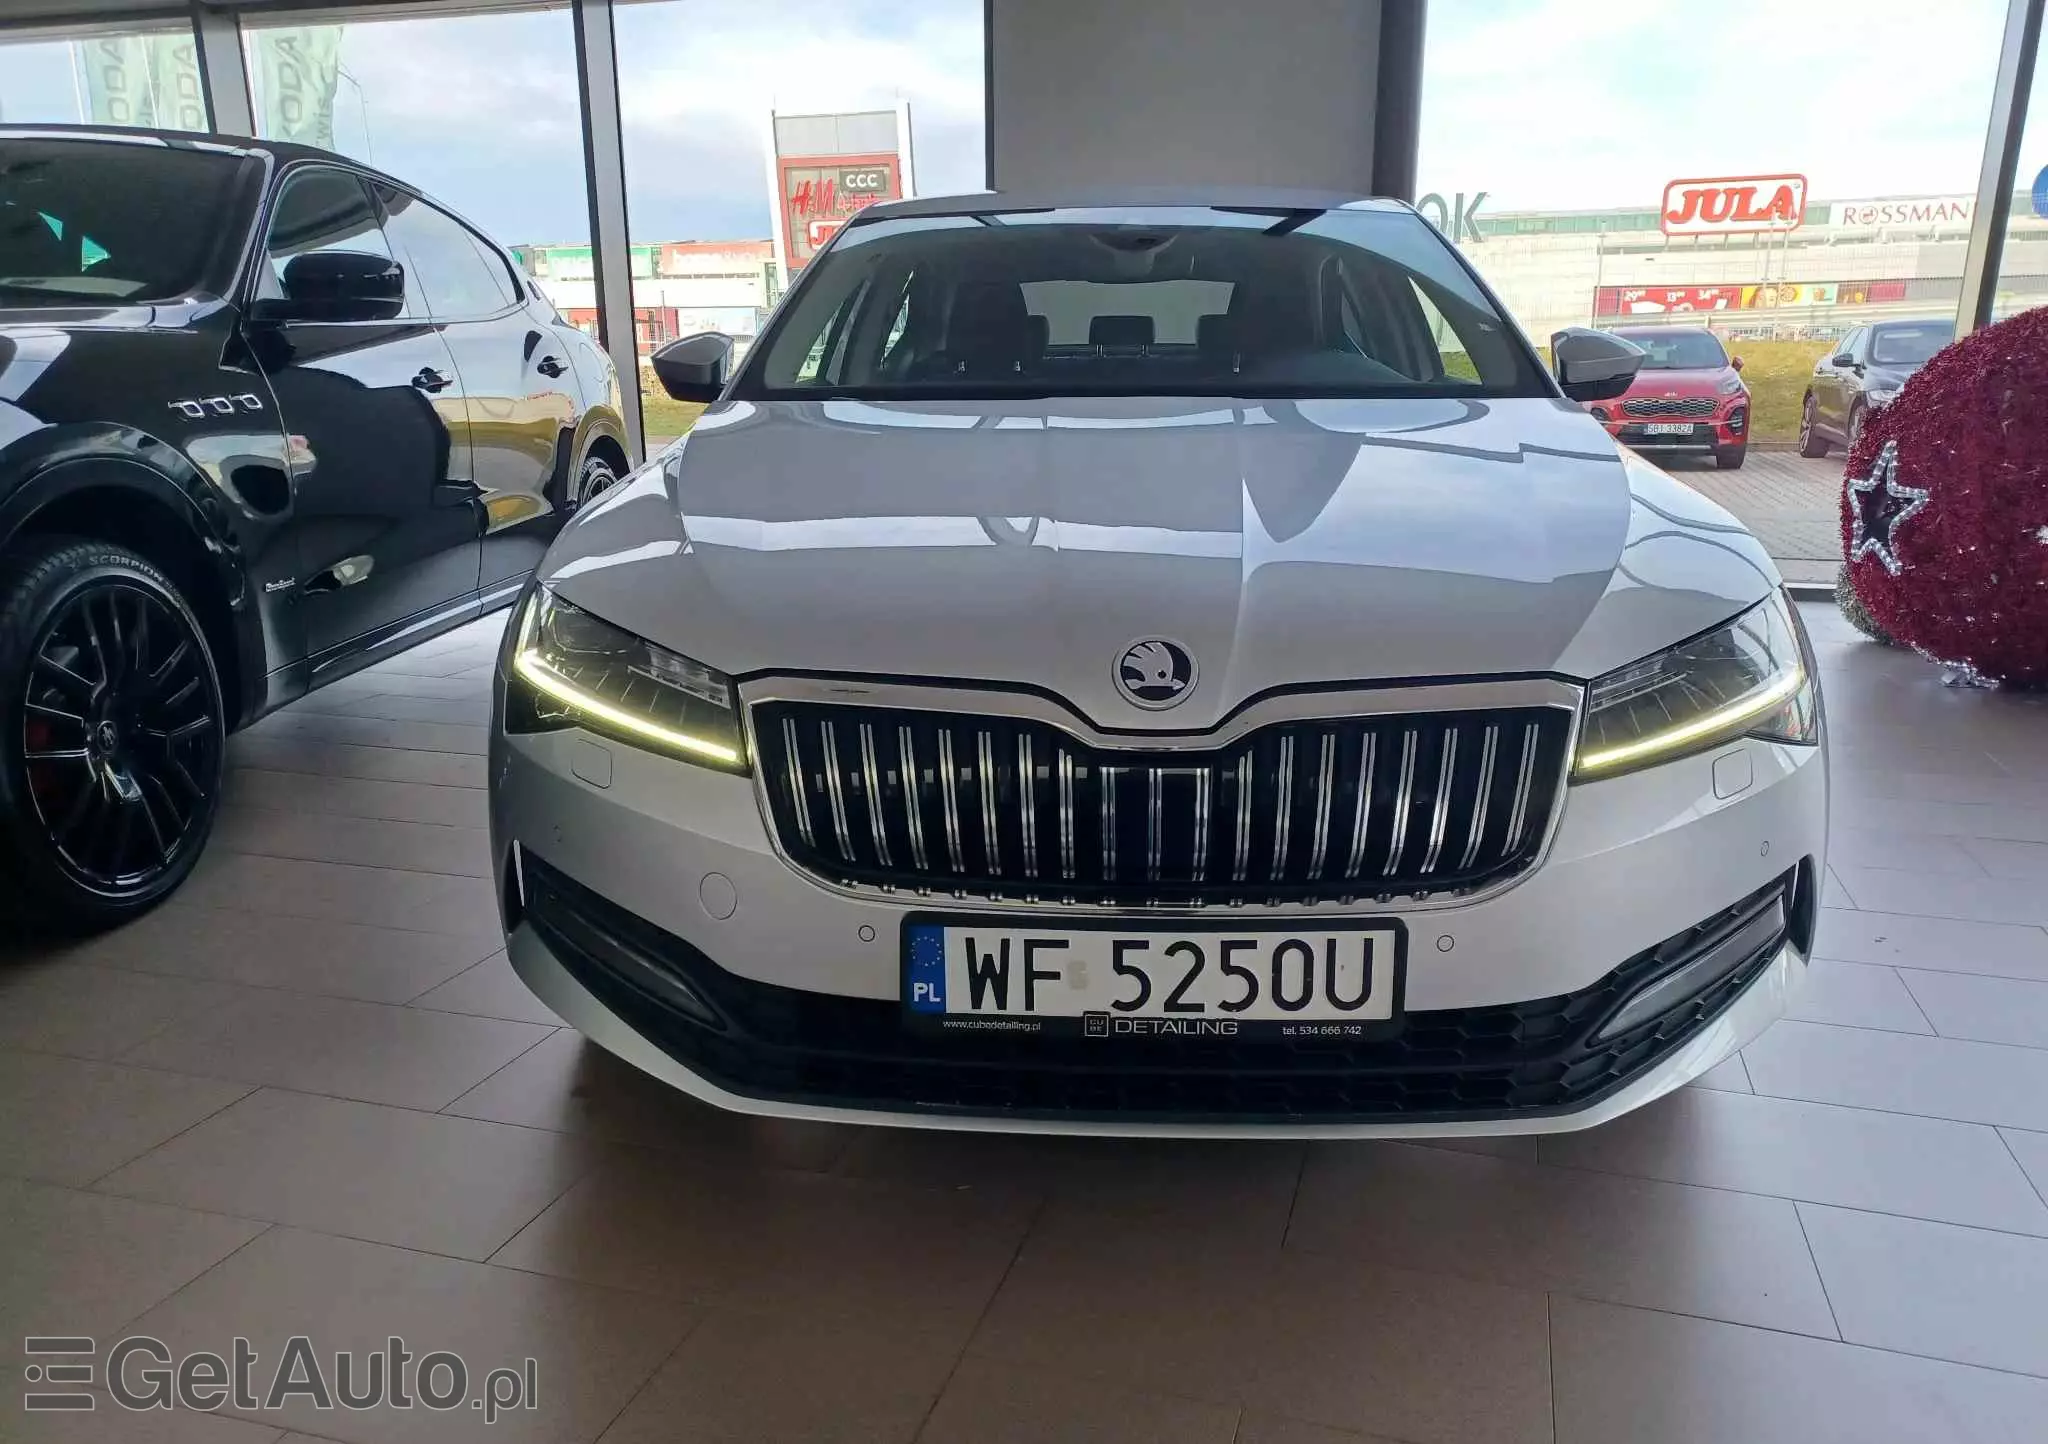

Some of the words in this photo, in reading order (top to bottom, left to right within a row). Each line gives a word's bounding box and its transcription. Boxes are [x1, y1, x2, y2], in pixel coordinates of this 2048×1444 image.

[846, 174, 878, 188] CCC
[1666, 184, 1797, 224] JULA
[1843, 202, 1970, 225] ROSSMAN
[88, 554, 164, 583] SCORPION
[965, 936, 1070, 1012] WF
[913, 982, 941, 1003] PL
[1115, 1018, 1238, 1036] DETAILING
[1282, 1026, 1297, 1035] tel.
[1299, 1026, 1318, 1035] 534
[1343, 1026, 1362, 1035] 742
